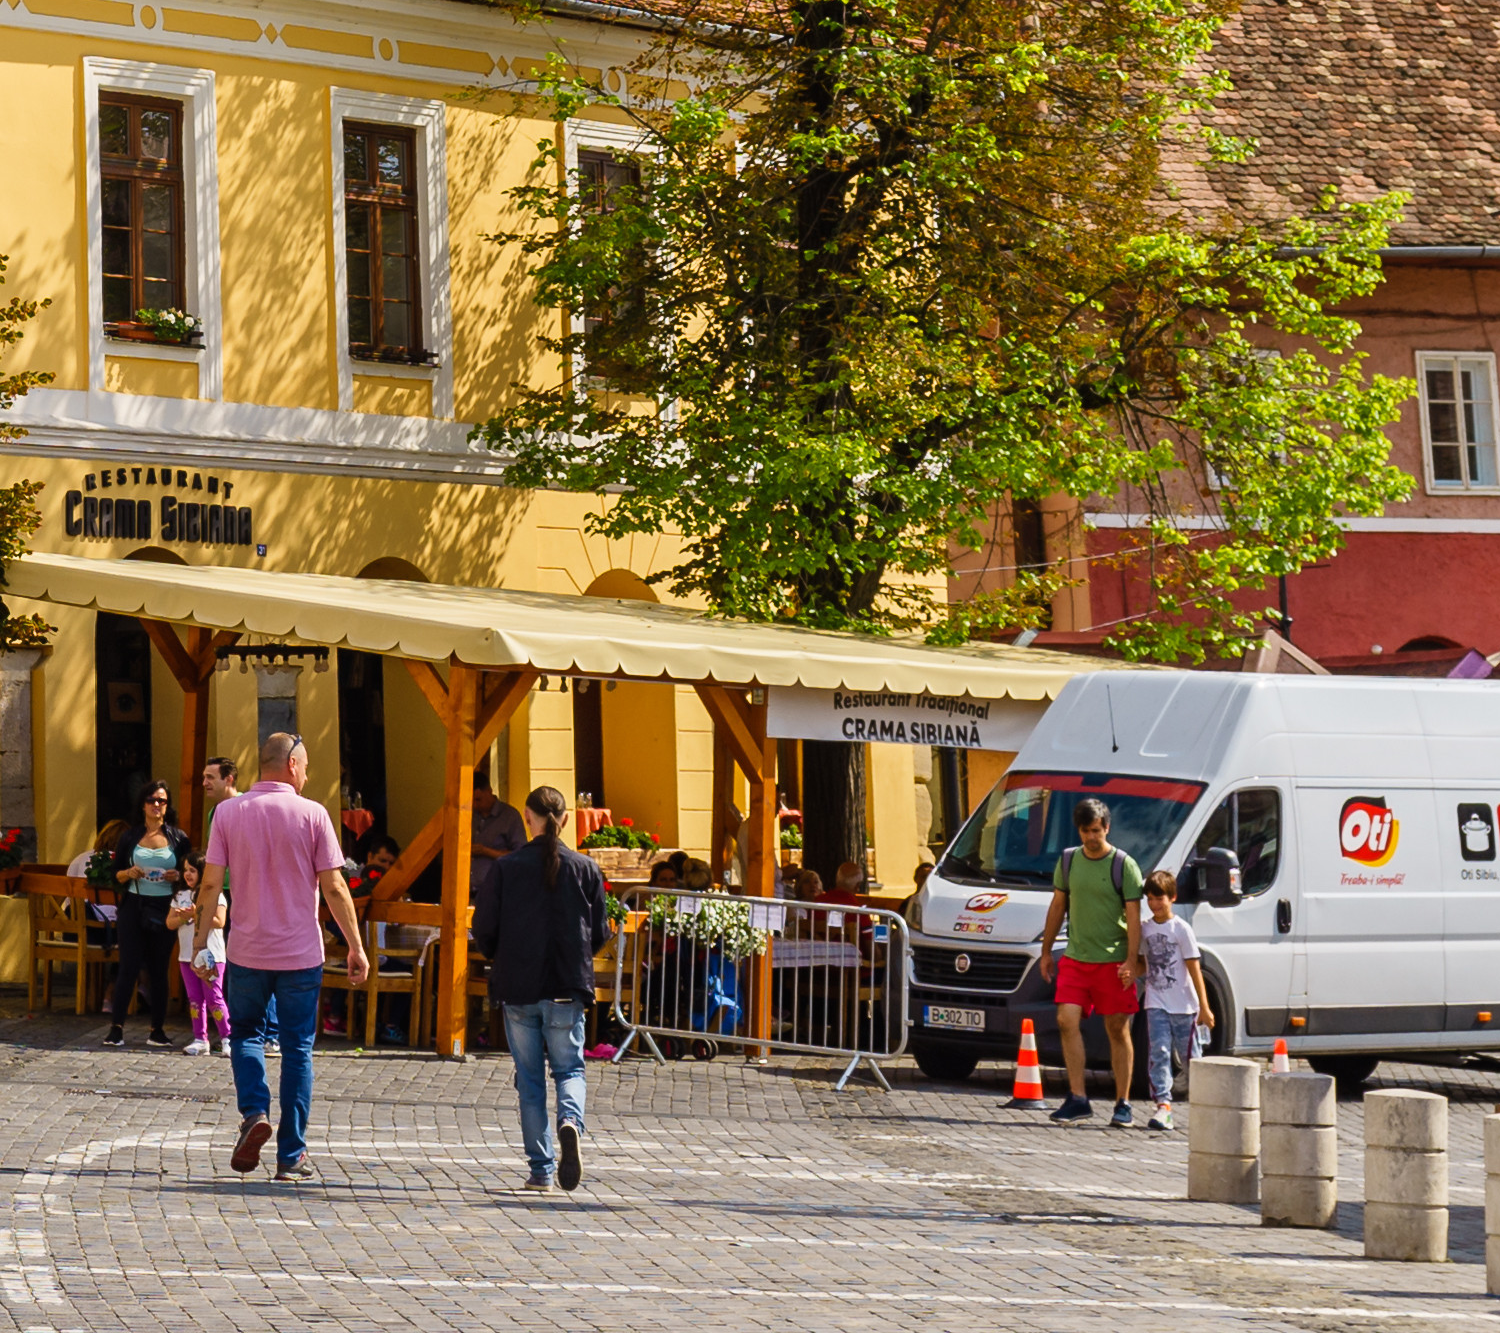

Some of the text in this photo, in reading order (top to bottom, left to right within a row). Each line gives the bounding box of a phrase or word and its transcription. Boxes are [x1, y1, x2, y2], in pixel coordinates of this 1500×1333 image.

[84, 467, 234, 499] RESTAURANT
[833, 691, 911, 711] Restaurant
[842, 717, 907, 743] CRAMA
[1342, 809, 1393, 852] Oti
[1461, 869, 1473, 880] Oti
[931, 1008, 940, 1022] B
[944, 1009, 962, 1024] 302
